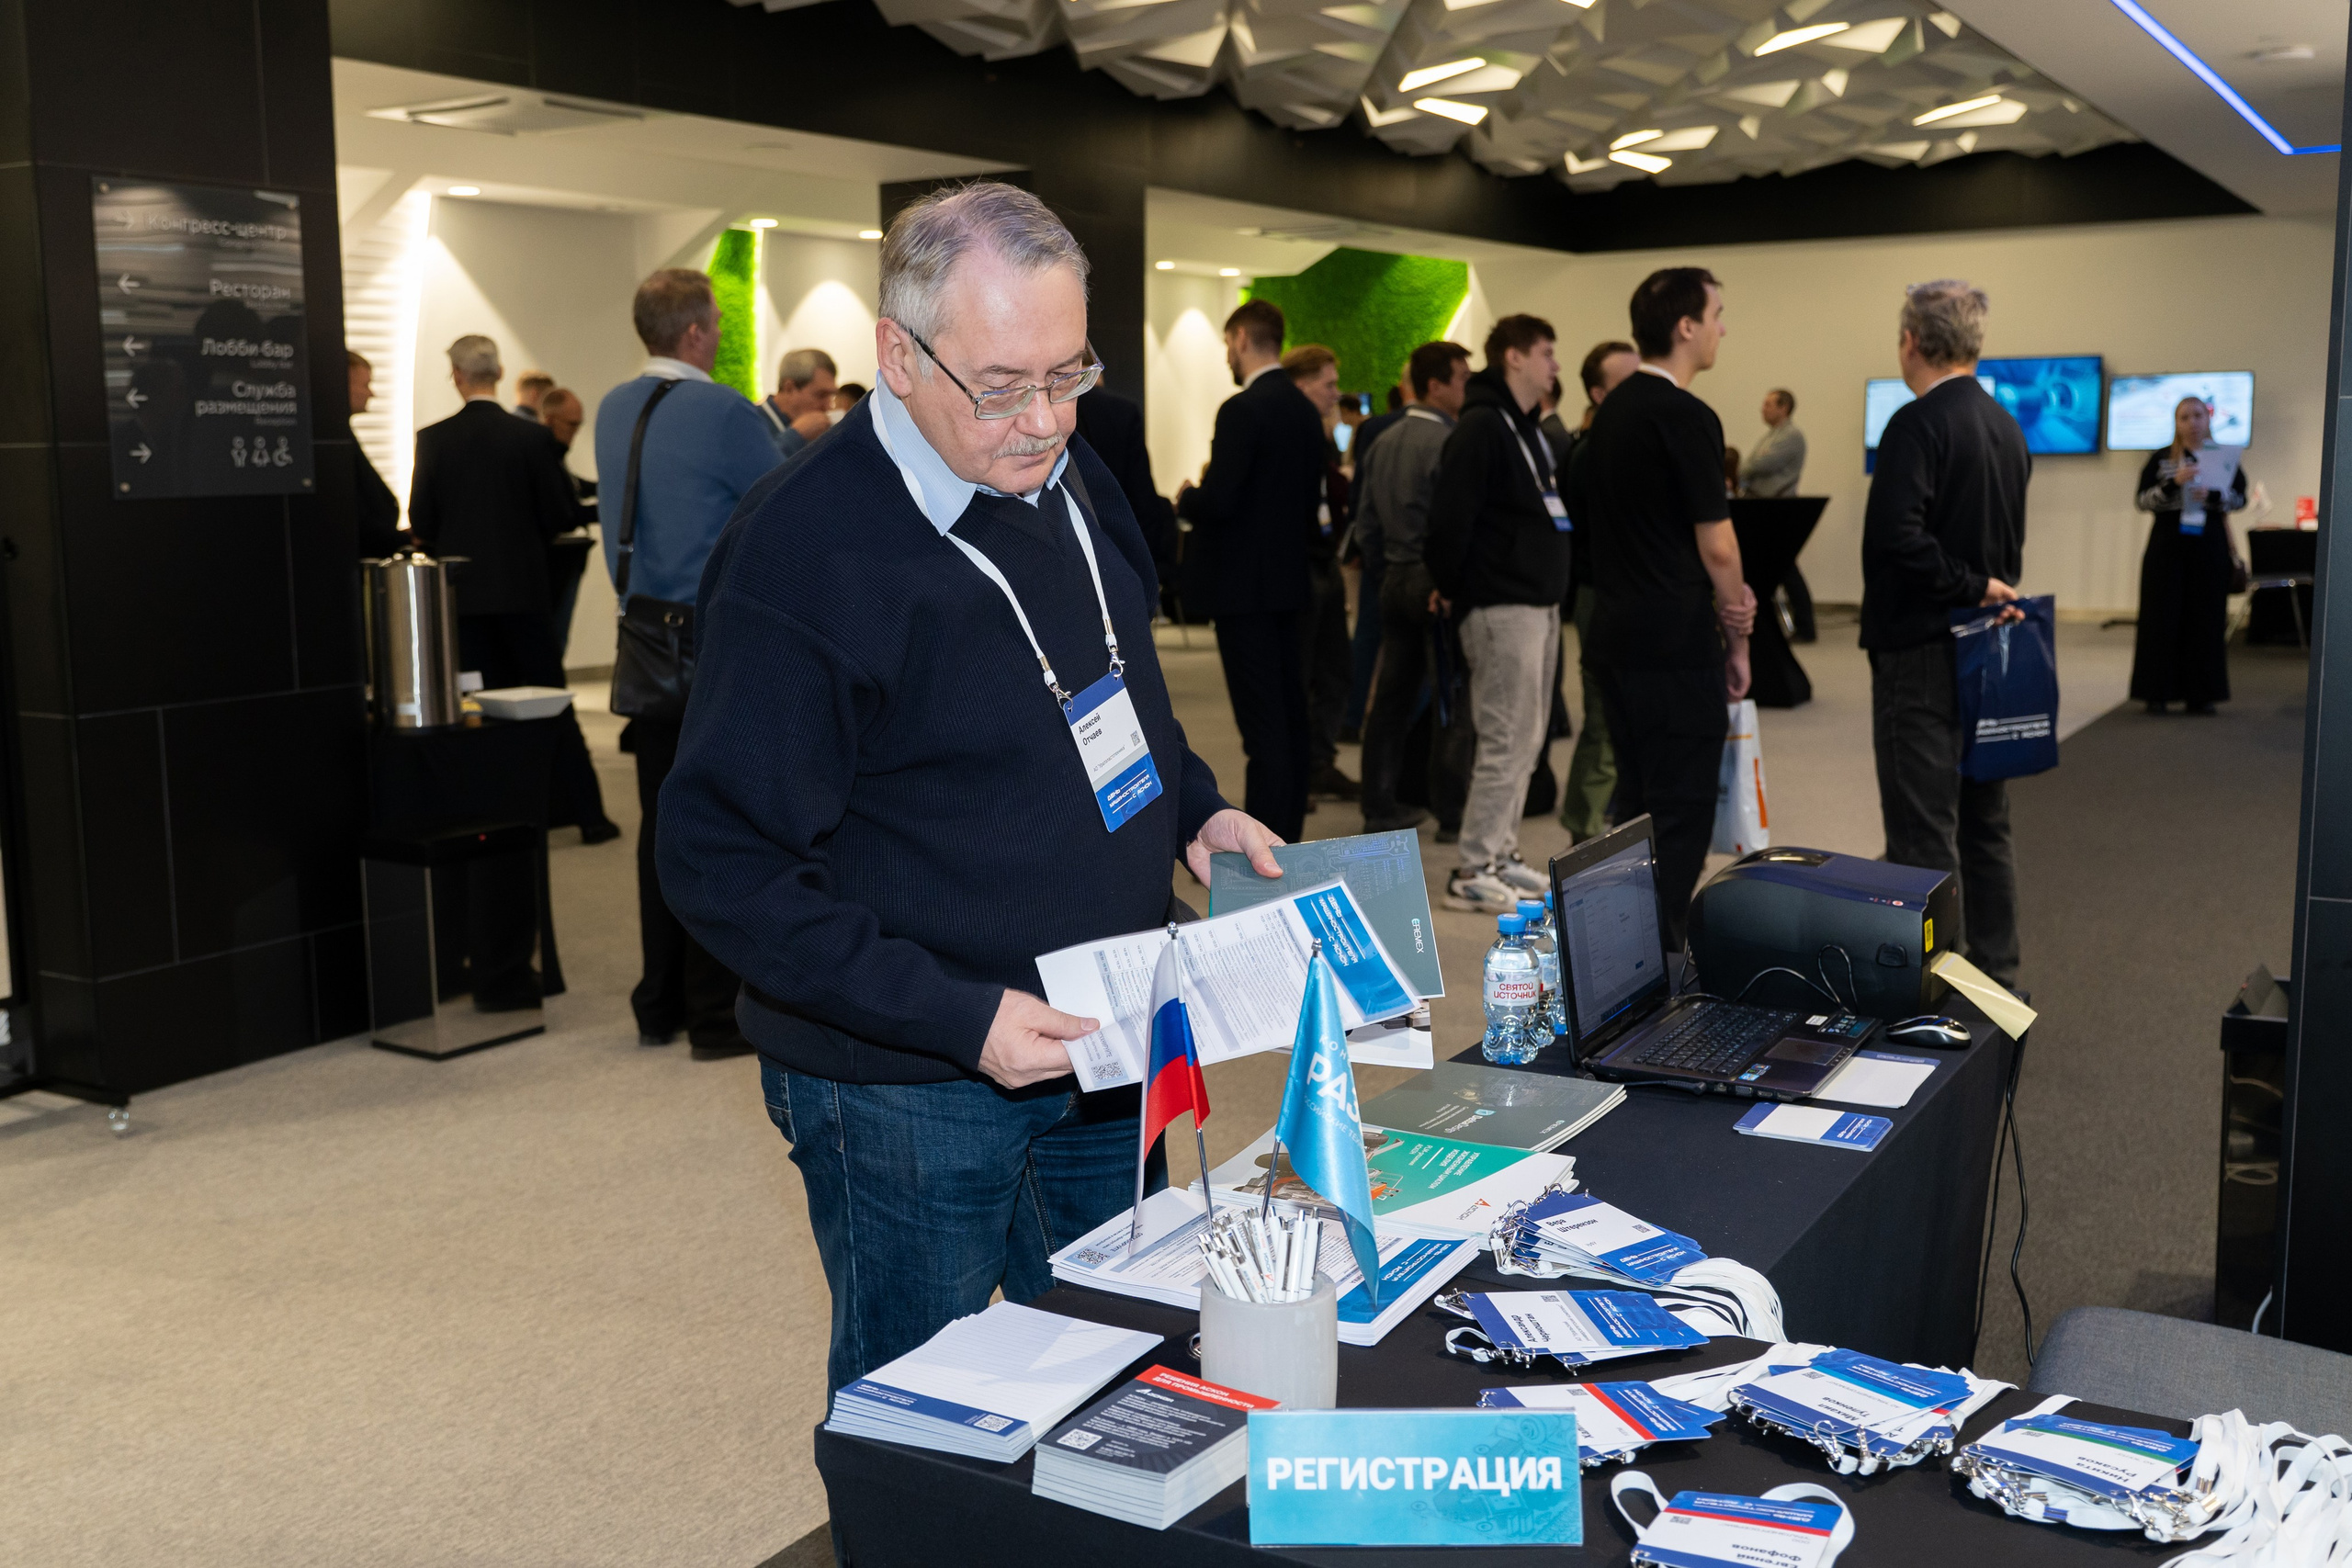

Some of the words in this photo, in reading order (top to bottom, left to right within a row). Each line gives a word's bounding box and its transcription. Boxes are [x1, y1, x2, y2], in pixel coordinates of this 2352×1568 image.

[209, 278, 291, 299] Ресторан
[232, 379, 297, 400] Служба
[195, 400, 298, 416] размещения
[1078, 713, 1101, 735] Алексей
[1082, 728, 1102, 746] Отчаев
[1328, 894, 1342, 919] ДЕНЬ
[1318, 897, 1358, 964] МАШИНОСТРОИТЕЛЯ
[1493, 990, 1537, 1000] ИСТОЧНИК
[1498, 981, 1534, 991] СВЯТОЙ
[1546, 1219, 1566, 1227] Вера
[1557, 1219, 1598, 1233] Штерензон
[1511, 1314, 1537, 1342] Александр
[1525, 1313, 1551, 1342] Черноштан
[1152, 1376, 1172, 1385] ДЛЯ
[1169, 1380, 1255, 1409] ПРОМЫШЛЕННОСТИ
[1159, 1372, 1201, 1389] РЕШЕНИЯ
[1199, 1384, 1230, 1397] АСКОН
[1818, 1403, 1860, 1421] Михаил
[1822, 1396, 1871, 1417] Туленков
[1267, 1457, 1562, 1497] РЕГИСТРАЦИЯ
[2076, 1462, 2130, 1483] Никита
[2077, 1456, 2138, 1478] Русаков
[1732, 1543, 1802, 1562] Фофанов
[1736, 1553, 1798, 1568] Евгений
